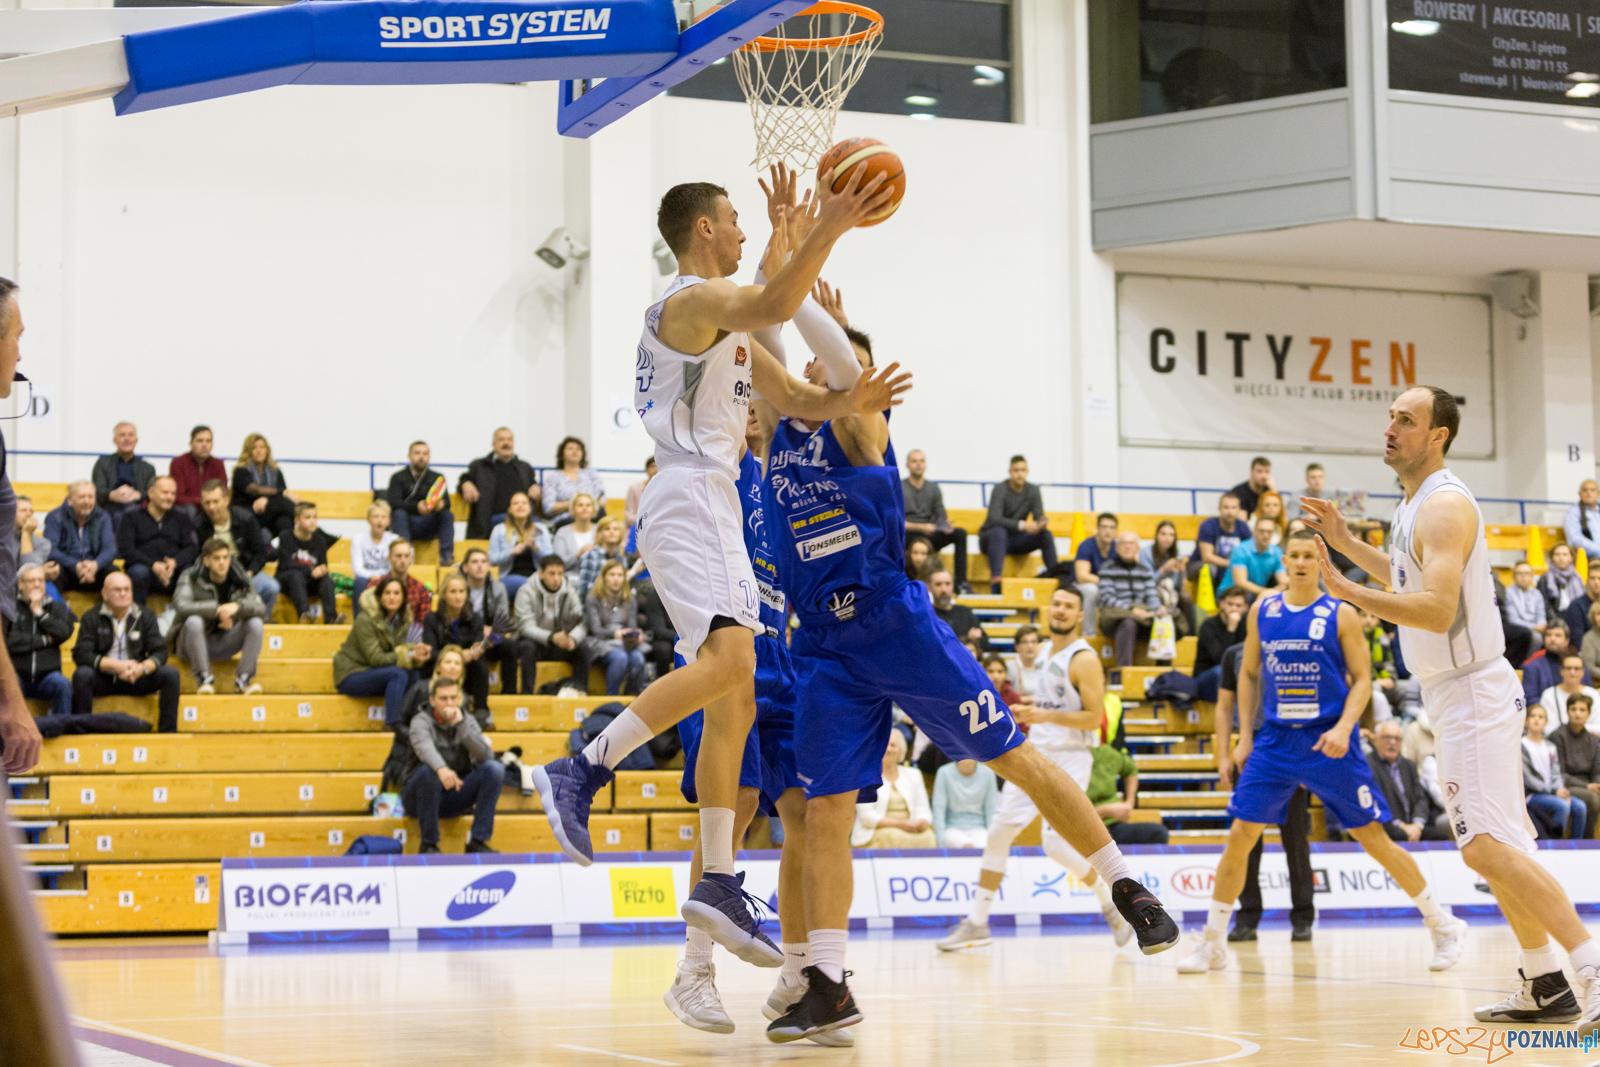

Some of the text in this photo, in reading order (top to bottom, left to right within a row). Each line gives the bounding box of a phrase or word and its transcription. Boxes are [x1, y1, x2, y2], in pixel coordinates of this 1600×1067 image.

[379, 8, 611, 43] SPORT SYSTEM
[1414, 0, 1476, 22] ROWERY
[1493, 7, 1571, 31] AKCESORIA
[1150, 327, 1416, 387] CITYZEN
[1312, 387, 1344, 400] KLUB
[32, 396, 49, 416] D
[614, 407, 631, 428] C
[1568, 444, 1580, 461] B
[1308, 618, 1327, 640] 6
[1275, 661, 1320, 673] KUTNO
[959, 689, 1005, 735] 22
[138, 751, 143, 760] 7
[158, 790, 163, 799] 7
[1357, 785, 1374, 809] 6
[235, 882, 381, 907] BIOFARM
[455, 886, 505, 905] atrem
